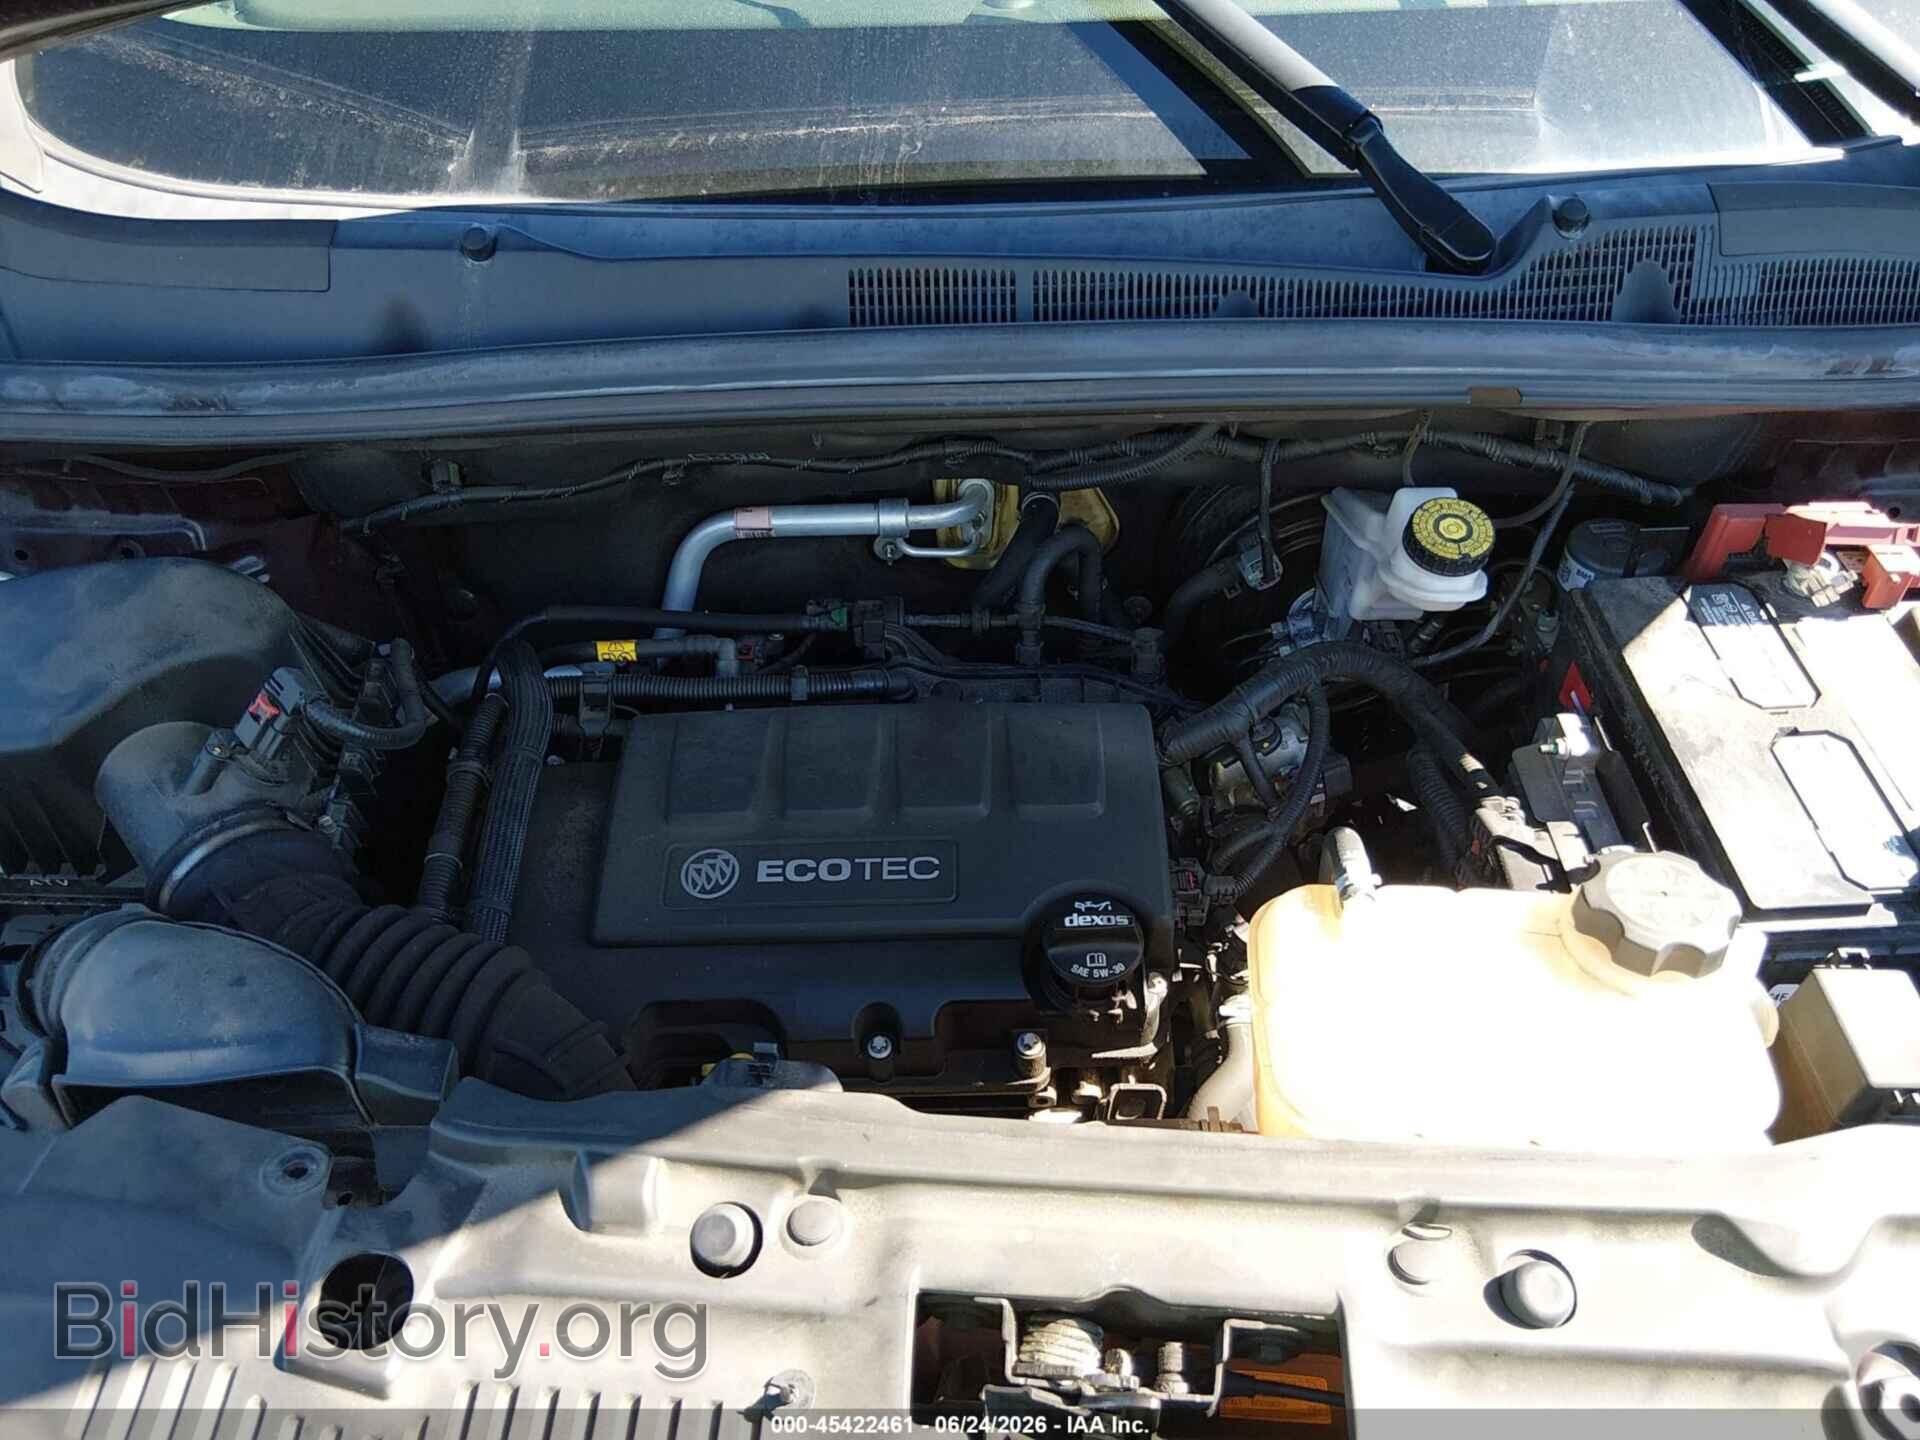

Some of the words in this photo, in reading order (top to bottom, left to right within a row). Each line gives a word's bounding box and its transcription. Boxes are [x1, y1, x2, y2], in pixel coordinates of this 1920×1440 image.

[756, 855, 941, 883] ECOTEC
[1064, 912, 1129, 928] dexos
[1071, 964, 1090, 978] SAE
[1093, 962, 1126, 978] 5W-30
